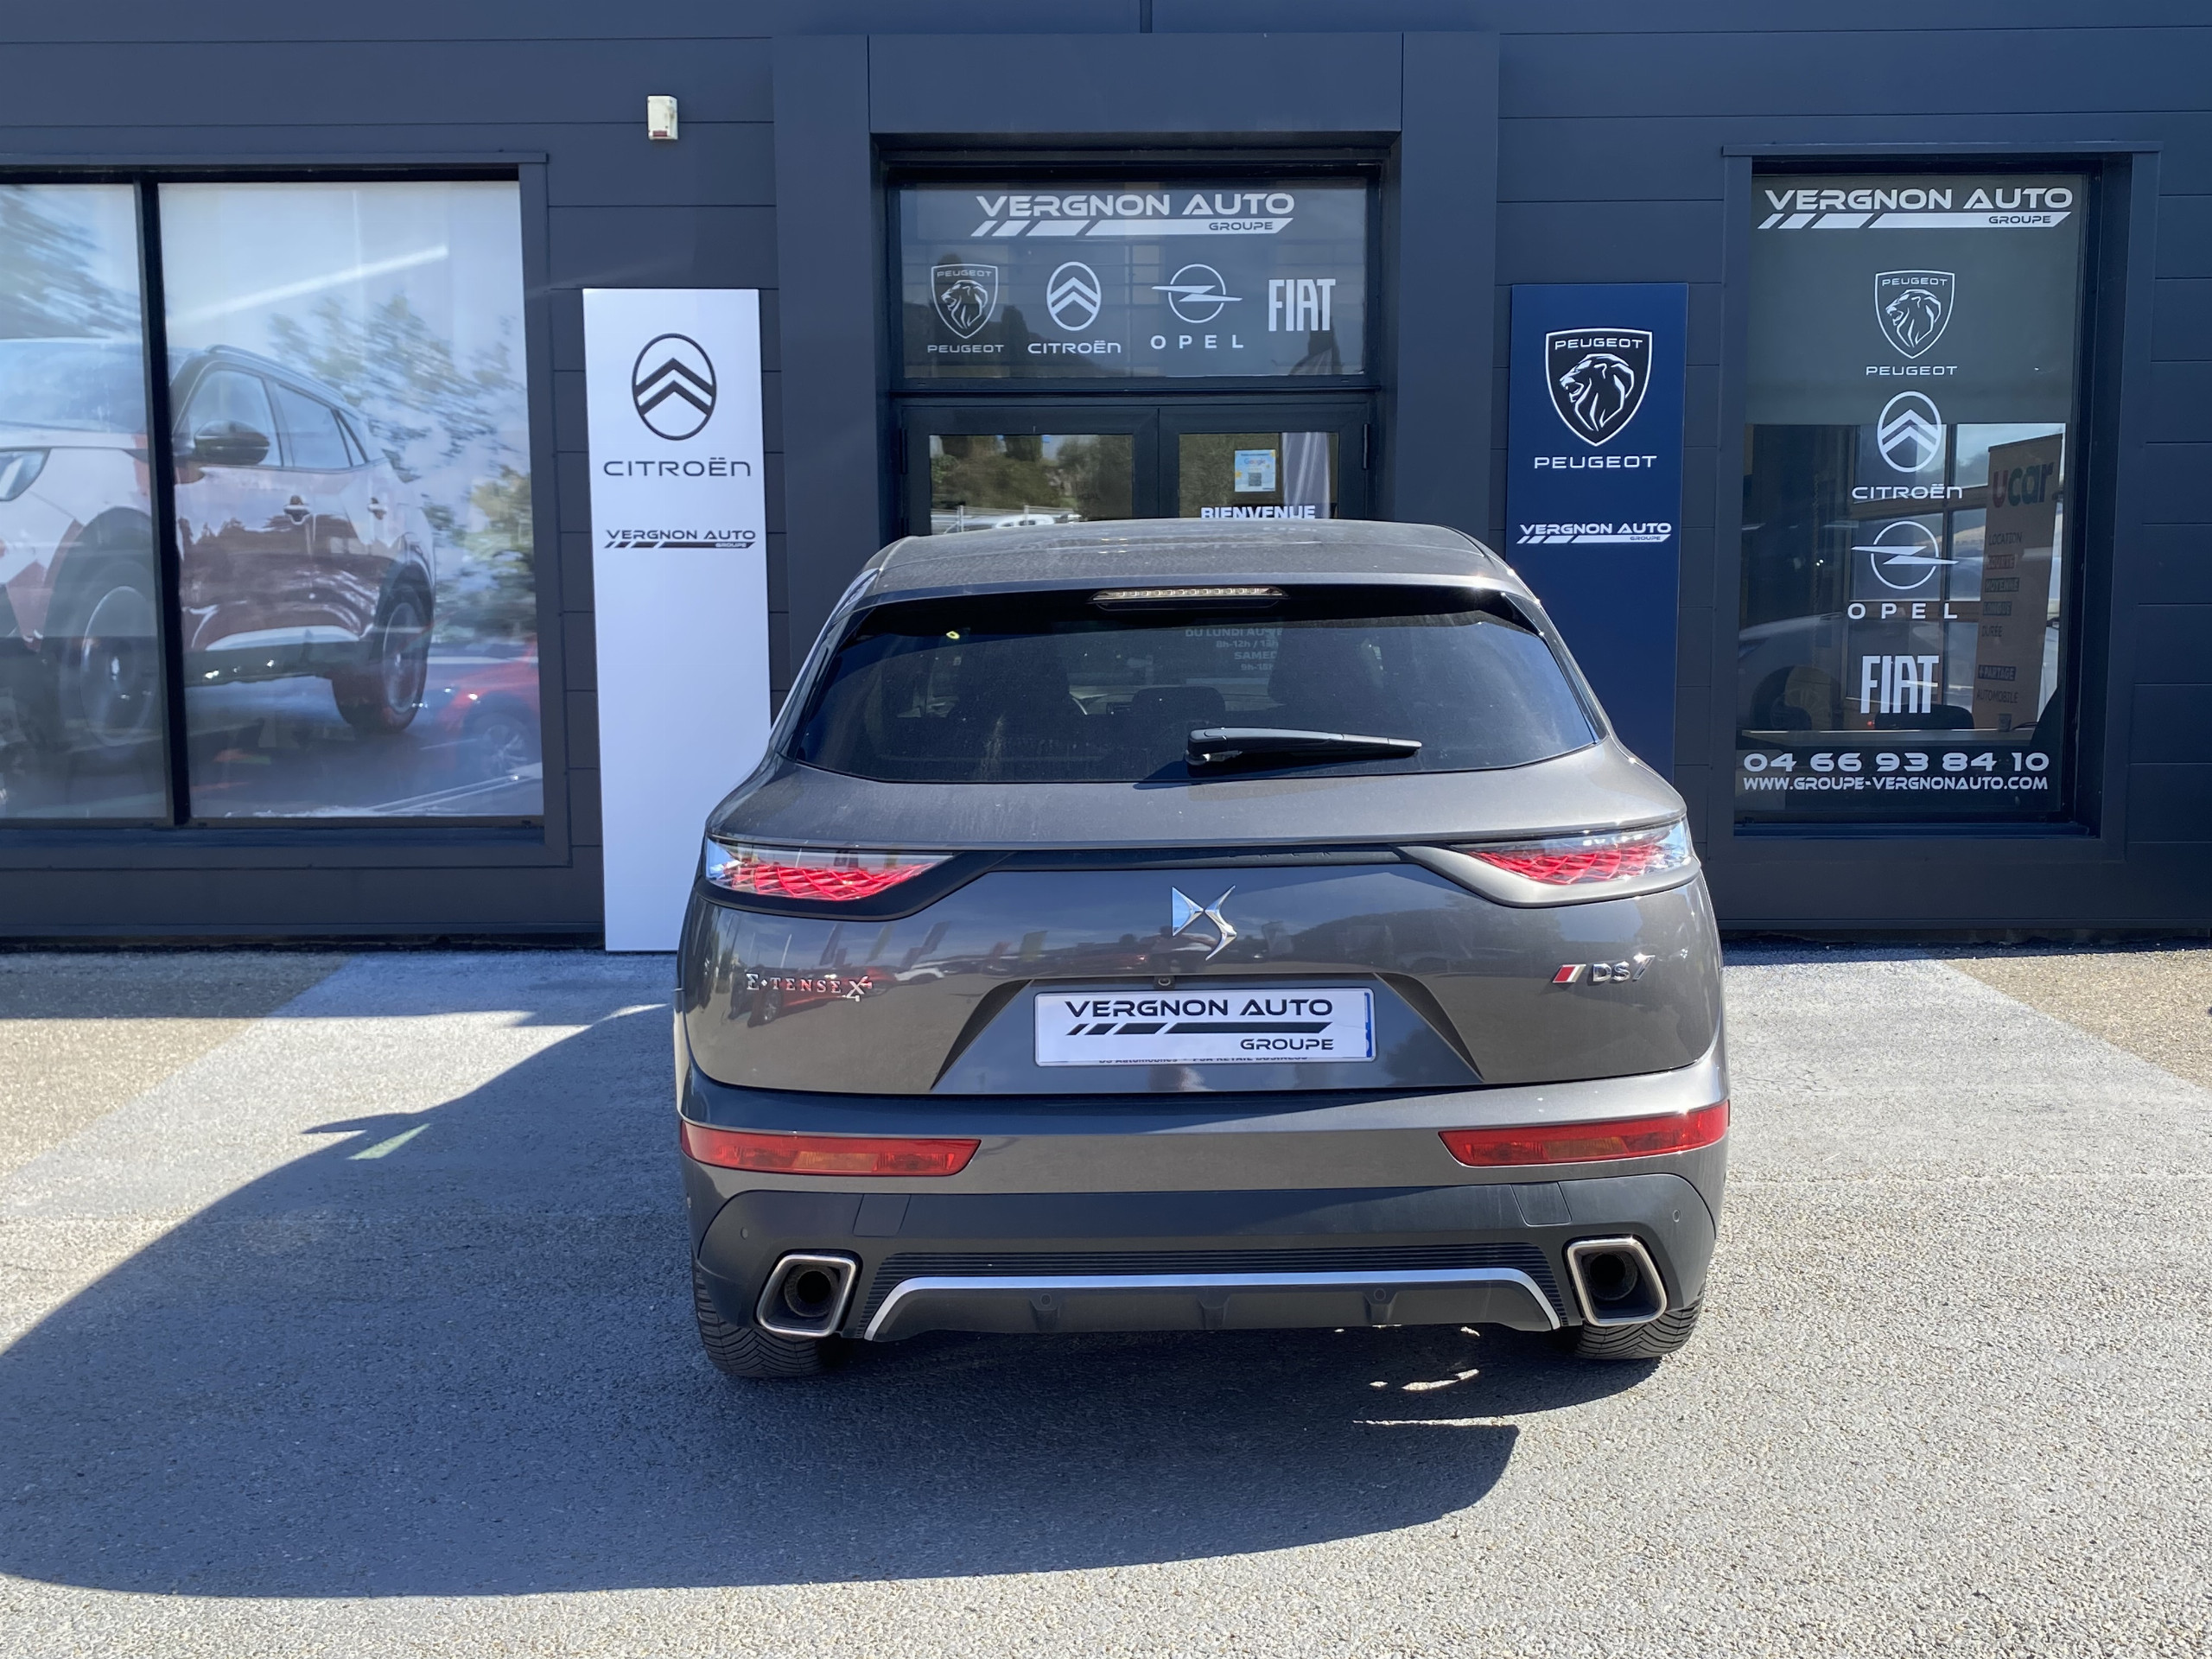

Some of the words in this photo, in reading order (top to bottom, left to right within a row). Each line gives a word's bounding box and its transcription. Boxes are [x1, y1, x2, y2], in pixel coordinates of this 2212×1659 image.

[976, 194, 1170, 217] VERGNON
[1182, 192, 1294, 214] AUTO
[1764, 188, 1953, 211] VERGNON
[1963, 187, 2073, 209] AUTO
[1209, 220, 1274, 232] GROUPE
[1988, 214, 2051, 225] GROUPE
[937, 269, 993, 278] PEUGEOT
[1881, 276, 1948, 287] PEUGEOT
[1268, 278, 1336, 331] FIAT
[927, 344, 1004, 353] PEUGEOT
[1027, 340, 1121, 354] CITROËN
[1150, 334, 1243, 350] OPEL
[1554, 338, 1643, 350] PEUGEOT
[1866, 365, 1958, 376] PEUGEOT
[604, 457, 751, 476] CITROËN
[1534, 455, 1657, 469] PEUGEOT
[1852, 483, 1962, 499] CITROËN
[1201, 505, 1315, 518] BIENVENUE
[606, 530, 697, 540] VERGNON
[703, 530, 756, 540] AUTO
[1519, 523, 1612, 535] VERGNON
[1618, 523, 1672, 534] AUTO
[1847, 602, 1958, 620] OPEL
[1206, 628, 1243, 637] LUNDI
[1860, 655, 1940, 714] FIAT
[1743, 753, 1797, 772] 04
[1809, 753, 1863, 772] 66
[1875, 753, 1929, 772] 93
[1942, 753, 1997, 772] 84
[2011, 753, 2050, 772] 10
[1743, 776, 2048, 791] WWW.GROUPE-VERGNONAUTO.COM
[1065, 999, 1228, 1018] VERGNON
[1239, 998, 1333, 1016] AUTO
[1240, 1038, 1334, 1051] GROUPE
